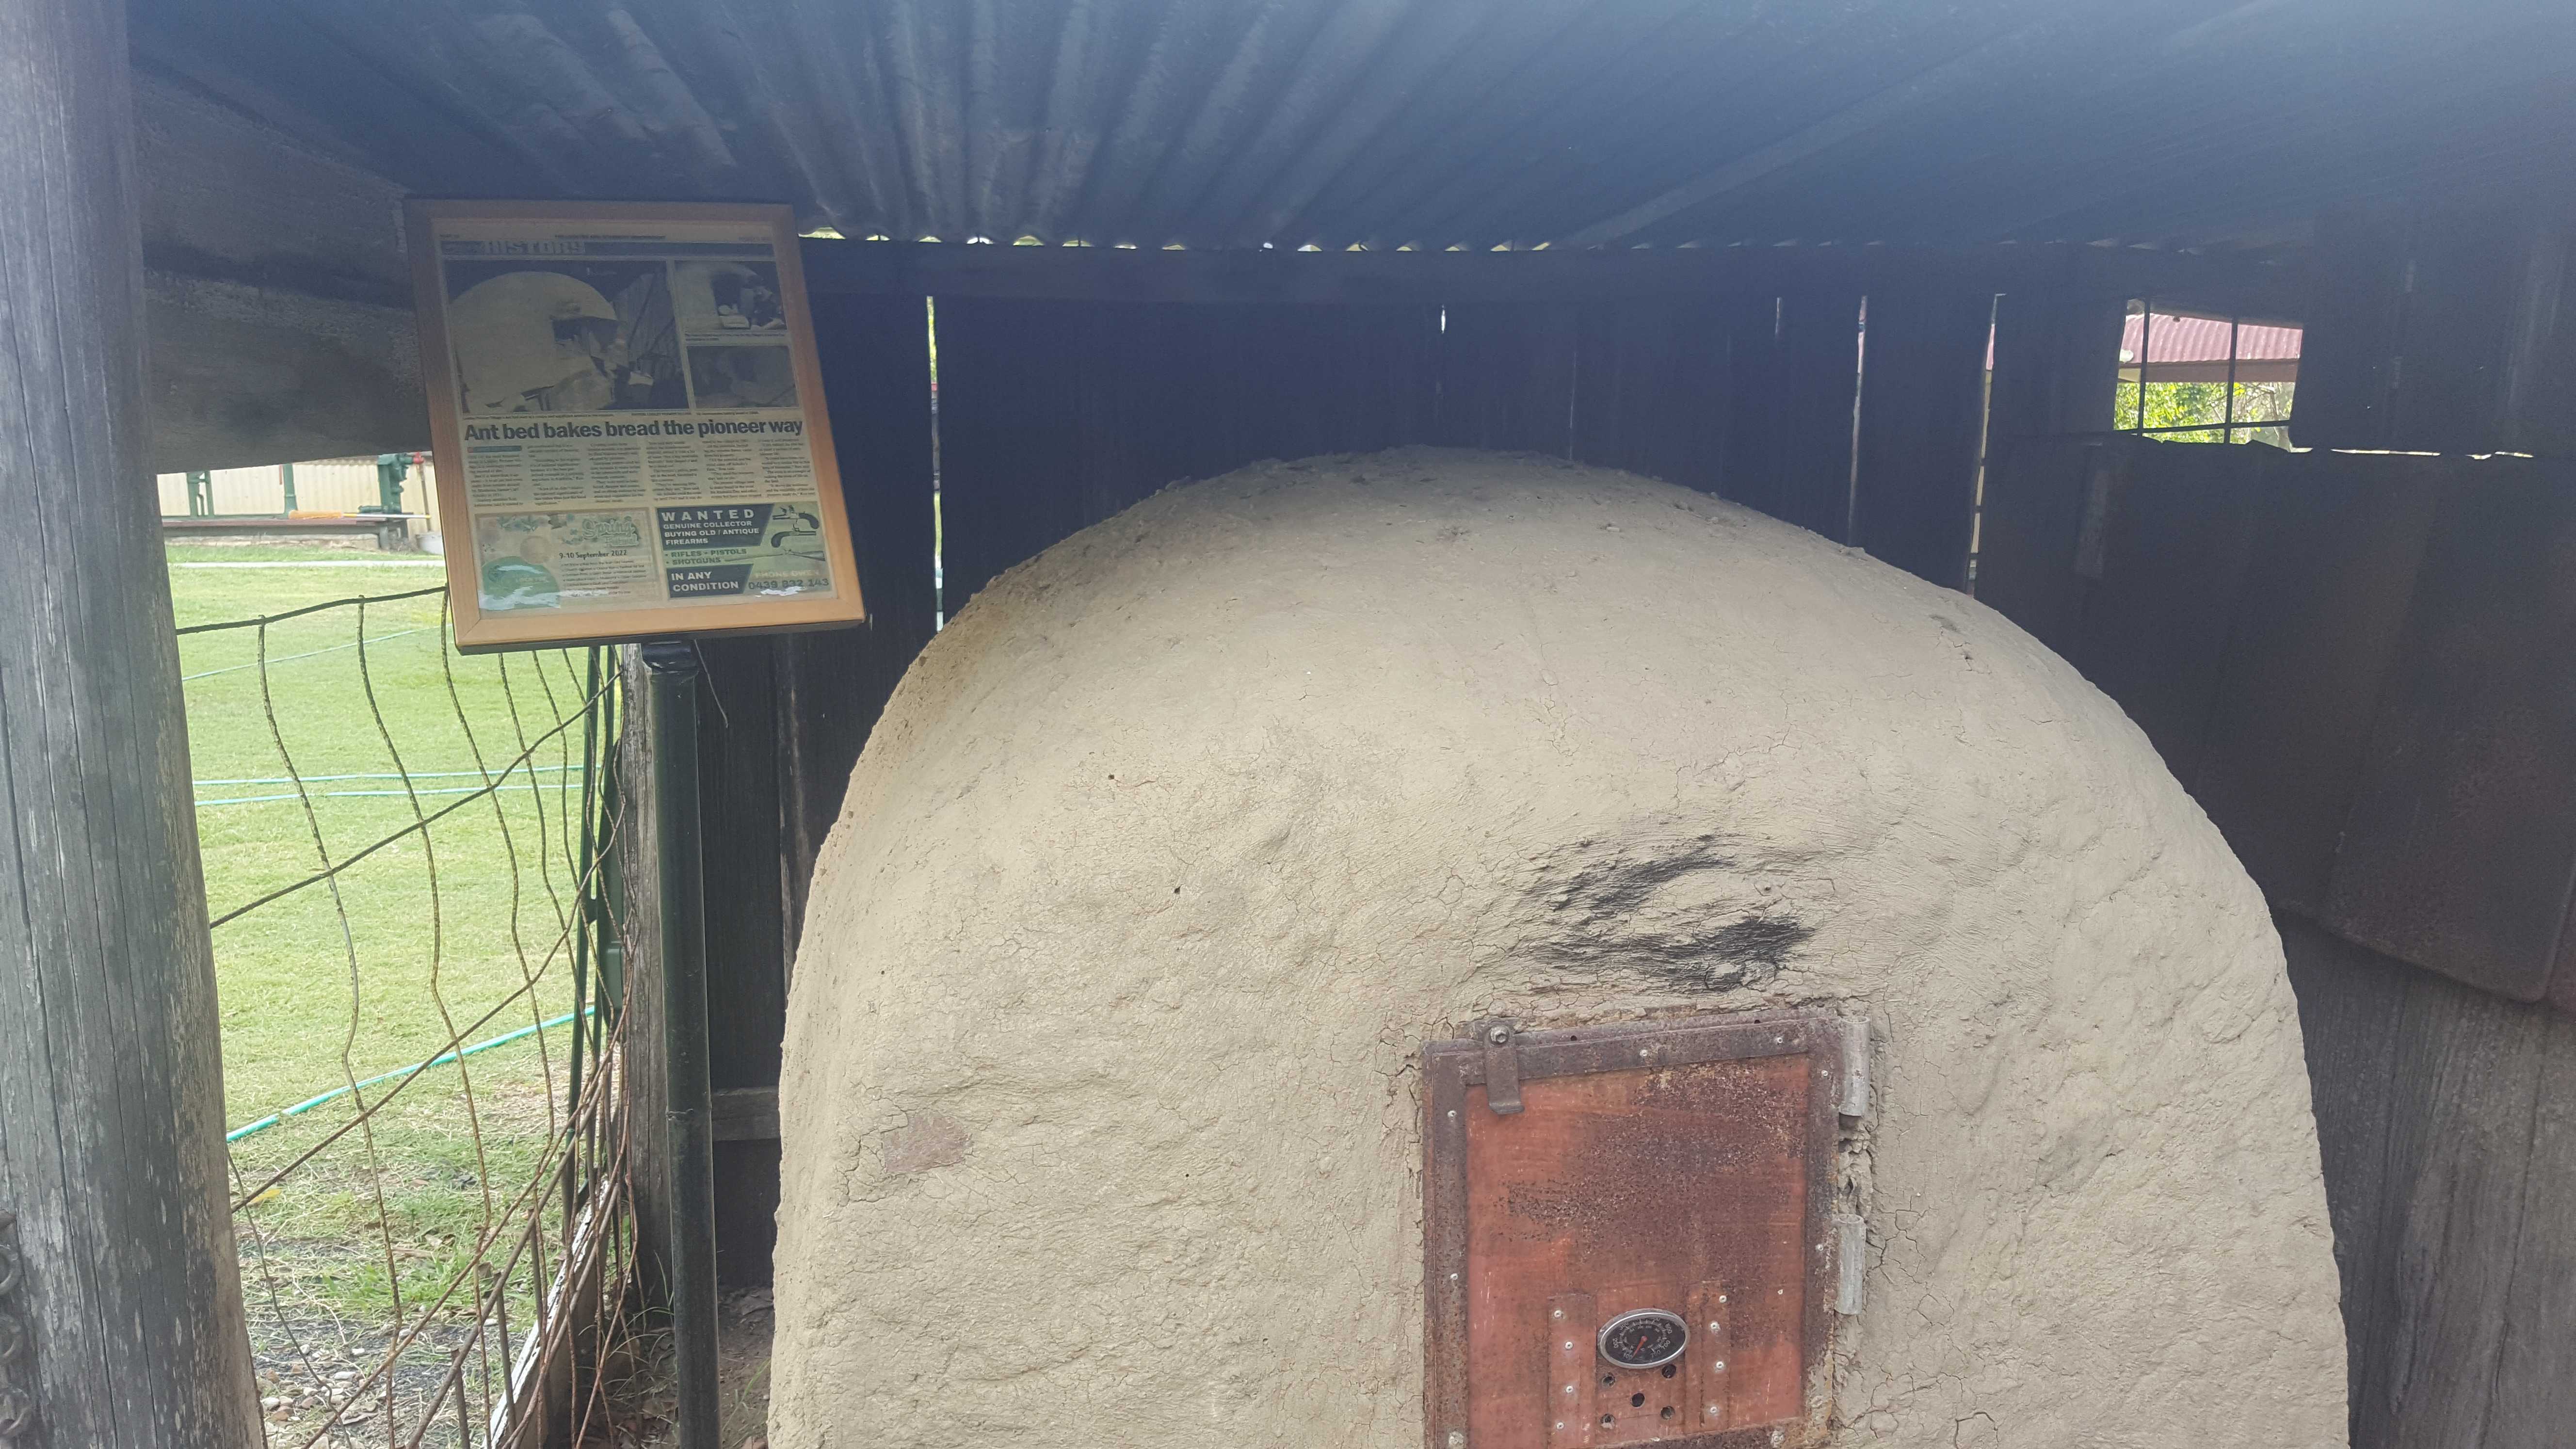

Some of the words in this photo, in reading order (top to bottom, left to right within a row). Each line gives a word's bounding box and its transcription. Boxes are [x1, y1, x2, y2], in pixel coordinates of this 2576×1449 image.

[464, 424, 500, 440] Ant
[502, 423, 539, 439] bed
[543, 422, 602, 438] bakes
[605, 420, 659, 437] bread
[663, 420, 694, 435] the
[698, 419, 766, 437] pioneer
[768, 420, 803, 436] way
[661, 509, 755, 522] WANTED
[581, 518, 635, 539] Spring
[576, 551, 609, 560] September
[671, 572, 684, 580] IN
[688, 571, 712, 580] ANY
[673, 581, 740, 592] CONDITION
